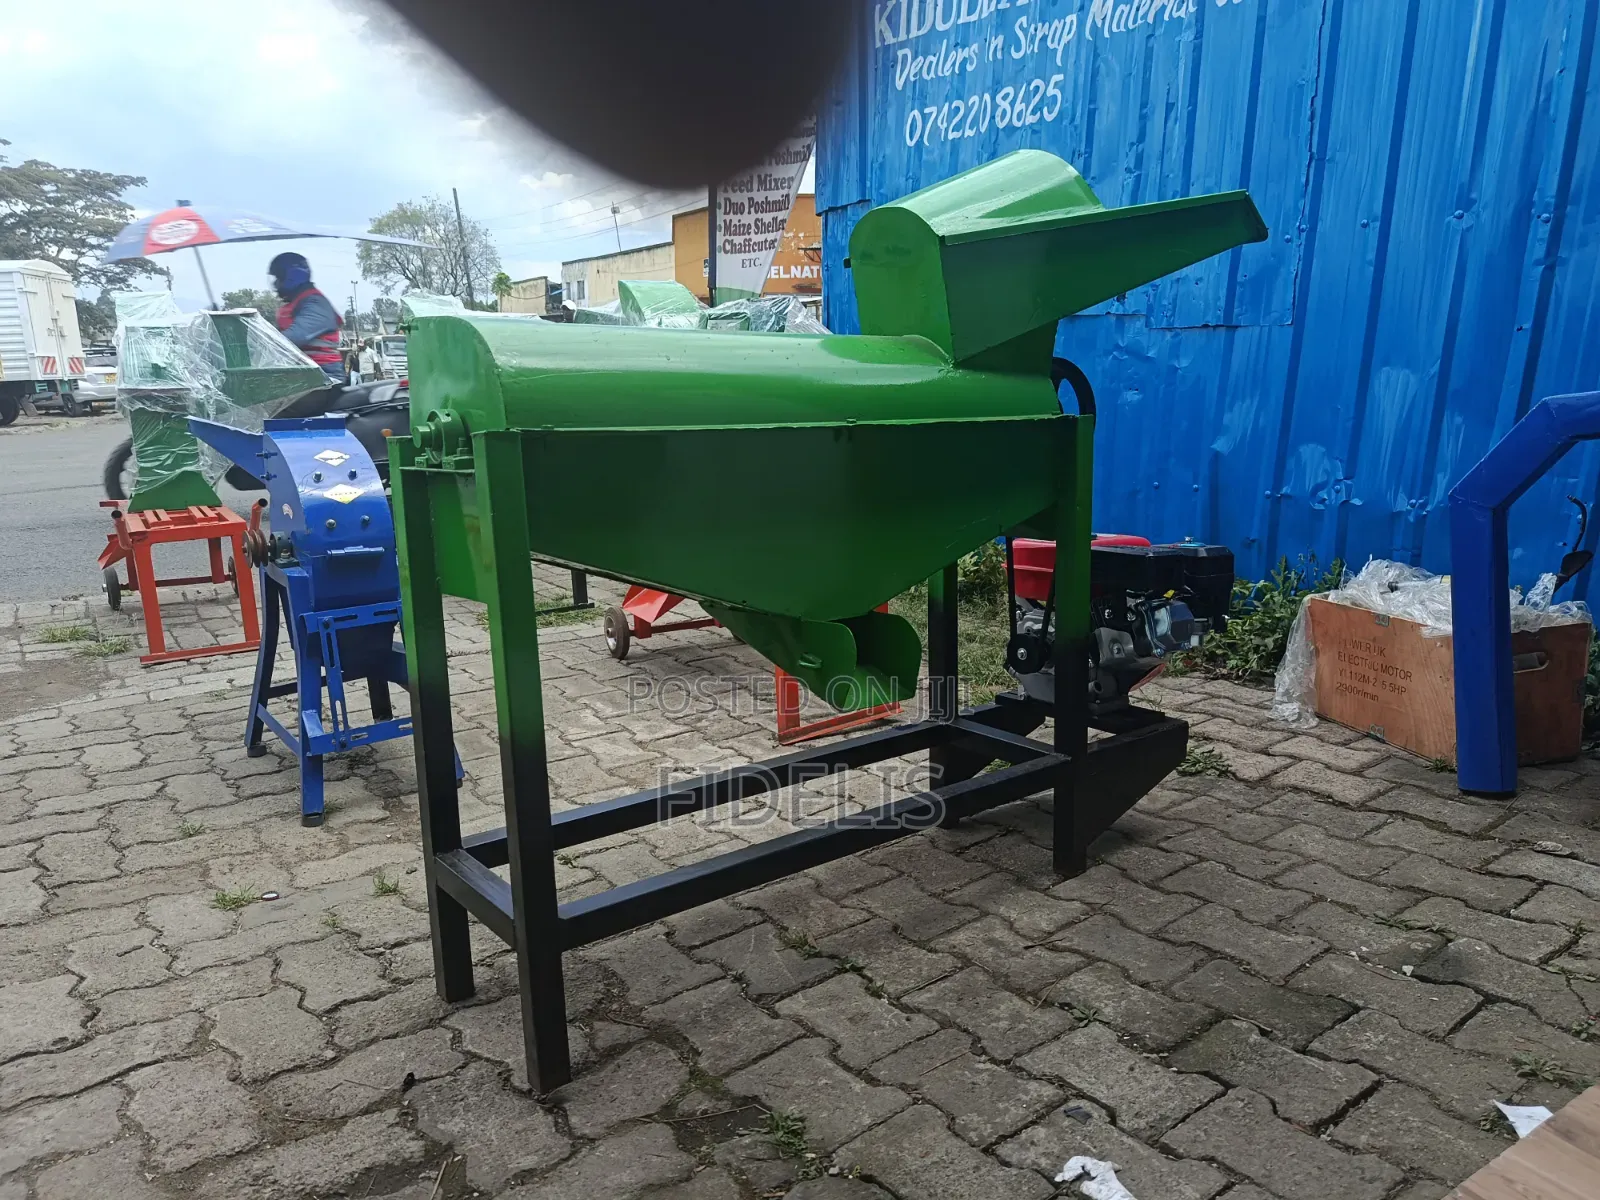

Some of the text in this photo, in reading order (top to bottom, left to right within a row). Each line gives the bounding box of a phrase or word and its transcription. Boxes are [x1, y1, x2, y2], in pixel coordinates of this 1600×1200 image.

[895, 39, 979, 91] Dealers
[1011, 13, 1077, 66] Scrap
[905, 73, 1064, 147] 0742208625
[757, 173, 794, 192] Mixer
[723, 197, 745, 215] Duo
[723, 216, 787, 237] Maize Sheller
[741, 257, 762, 269] ETC.
[767, 265, 823, 279] ELNAT
[1373, 645, 1386, 658] UK
[1337, 651, 1412, 683] ELECTRIC MOTOR
[1336, 682, 1379, 702] 2900r/min
[1382, 680, 1407, 697] 55HP
